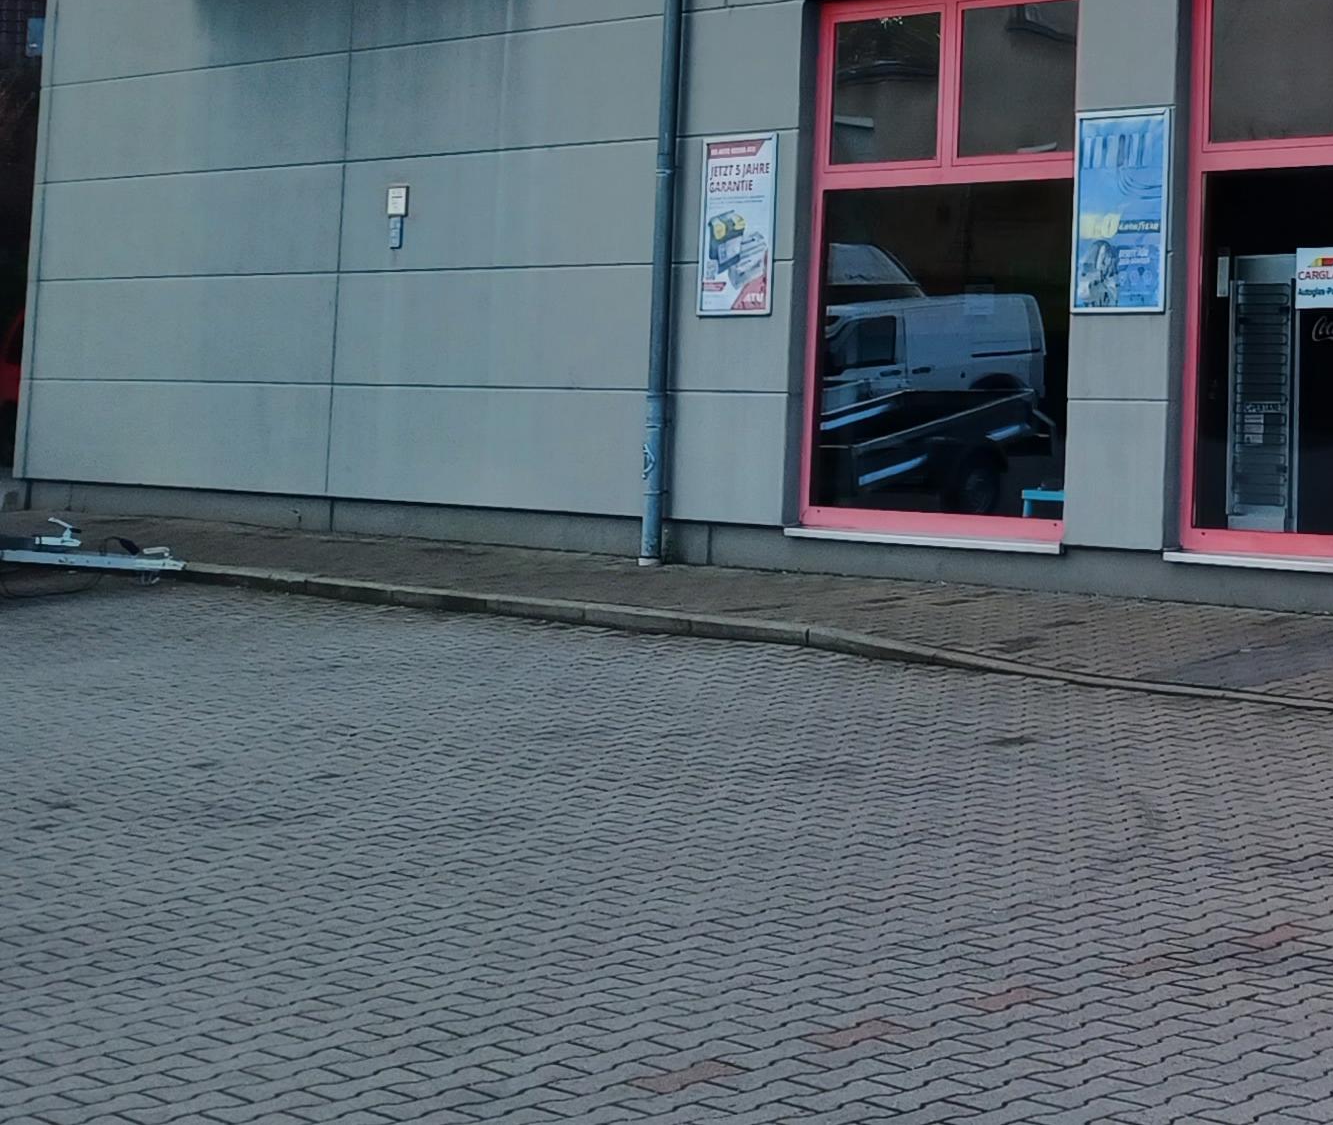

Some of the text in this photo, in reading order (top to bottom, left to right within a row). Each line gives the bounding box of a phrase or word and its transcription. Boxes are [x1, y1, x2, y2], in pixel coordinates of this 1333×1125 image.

[710, 162, 771, 180] JETZT 5 JAHRE
[709, 179, 753, 193] GARANTIE
